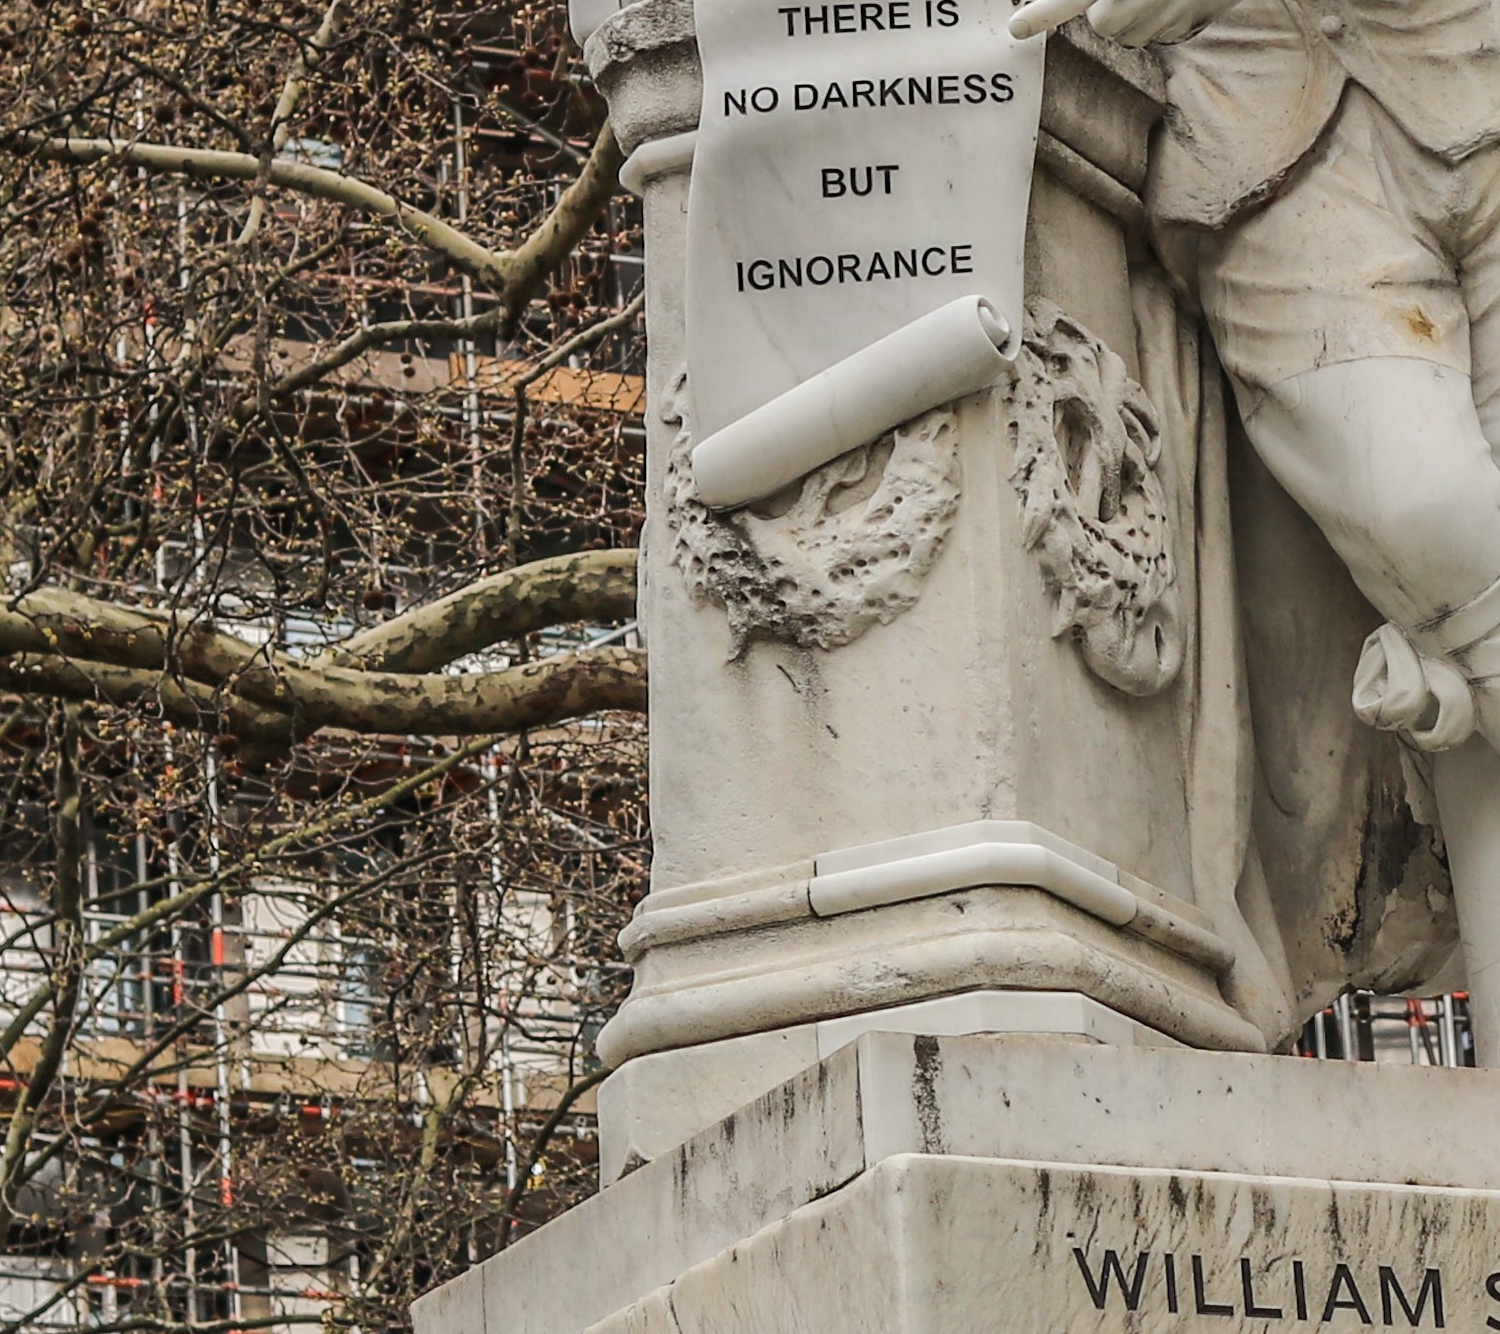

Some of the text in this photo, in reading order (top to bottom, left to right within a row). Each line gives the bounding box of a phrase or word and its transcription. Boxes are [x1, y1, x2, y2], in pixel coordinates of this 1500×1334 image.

[778, 2, 911, 37] THERE
[724, 73, 1014, 117] NO DARKNESS
[821, 164, 899, 198] BUT
[736, 244, 973, 292] IGNORANCE
[1072, 1246, 1445, 1329] WILLIAM
